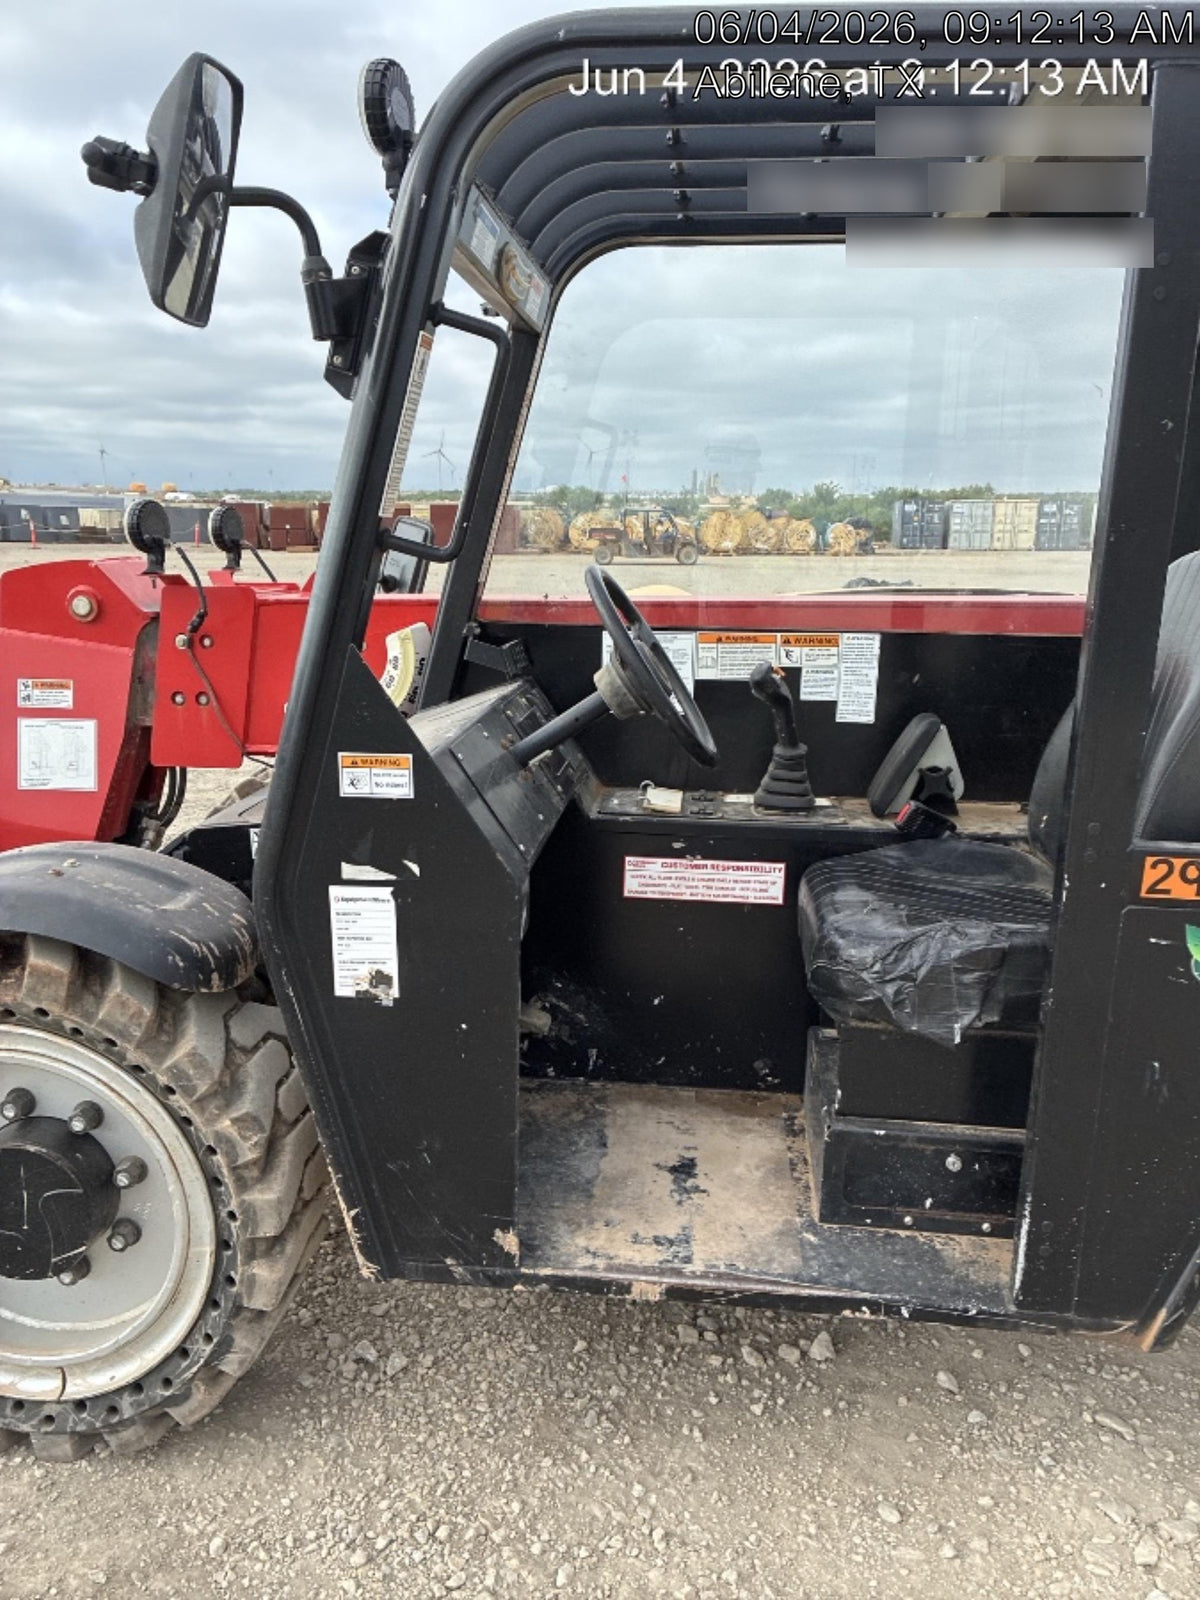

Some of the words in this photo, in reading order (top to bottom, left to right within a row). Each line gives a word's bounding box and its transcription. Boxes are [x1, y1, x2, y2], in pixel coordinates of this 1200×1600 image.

[360, 758, 401, 767] WARNING
[660, 861, 709, 871] CUSTOMER
[710, 862, 783, 874] RESPONSIBILITY
[1145, 858, 1200, 897] 29
